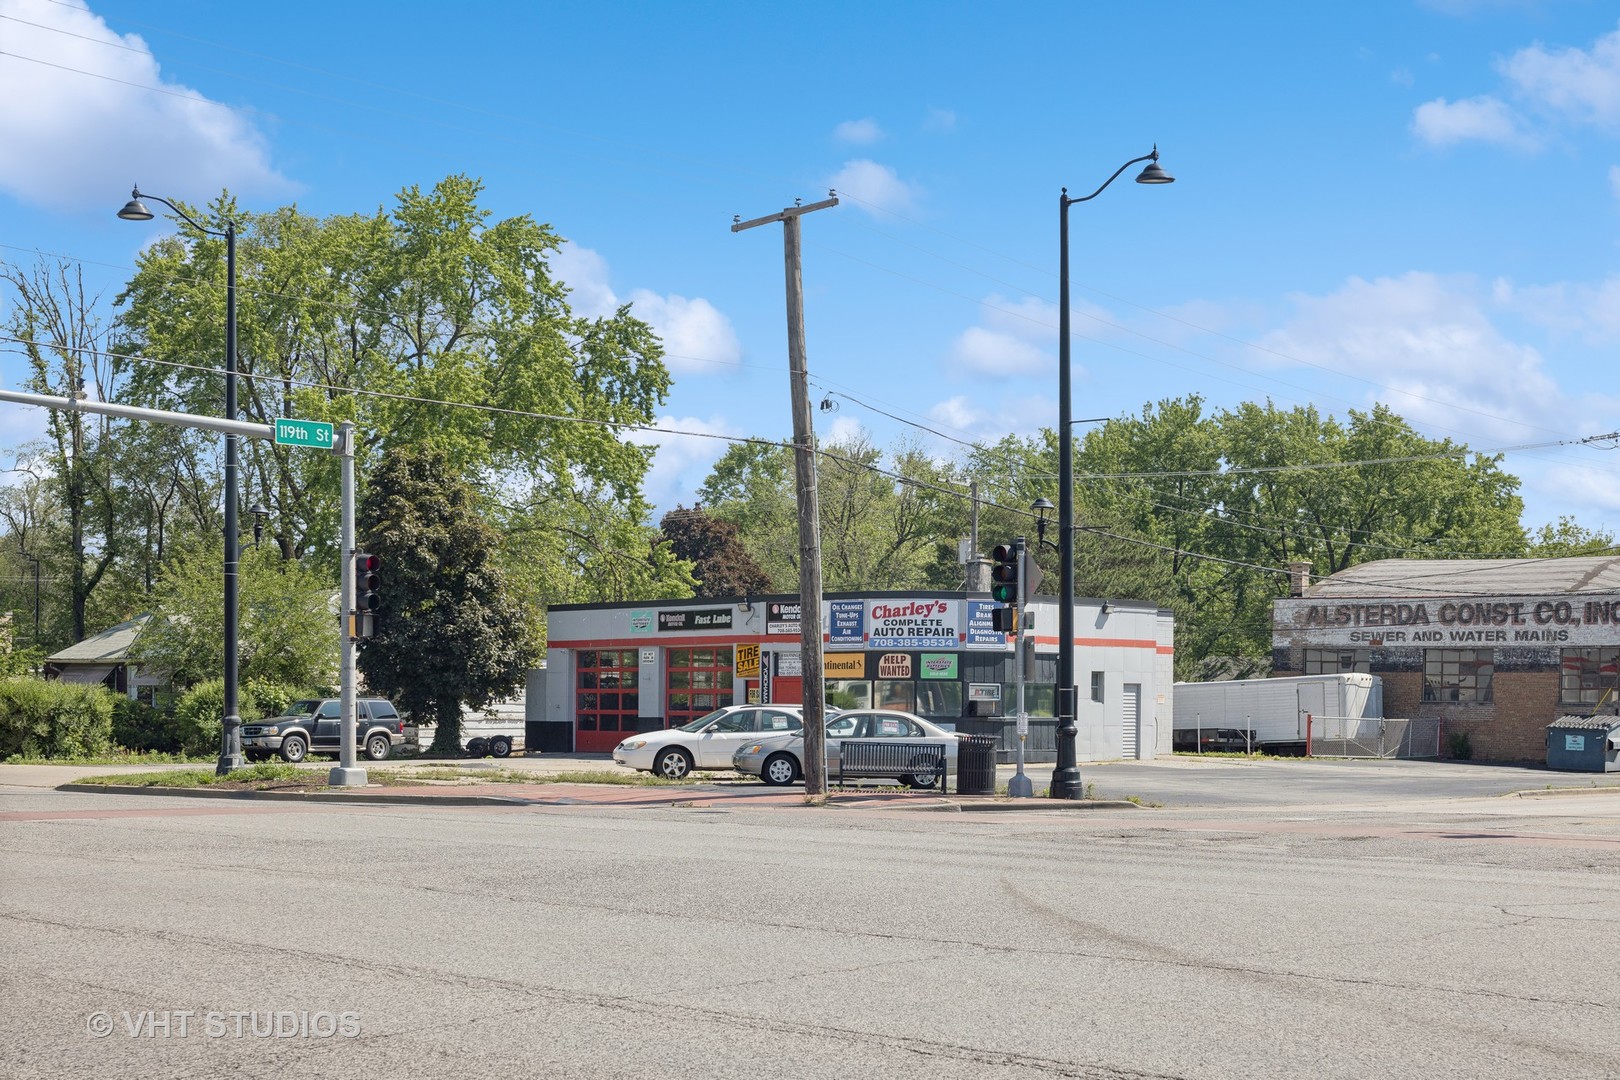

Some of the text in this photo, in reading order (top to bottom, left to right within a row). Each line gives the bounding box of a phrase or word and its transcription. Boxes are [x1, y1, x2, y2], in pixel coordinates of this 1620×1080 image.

[280, 426, 329, 442] 119th St
[871, 600, 947, 620] Charley's
[1306, 604, 1430, 626] ALSTERDA
[1438, 602, 1526, 626] CONST.
[694, 615, 711, 625] Fast
[712, 614, 732, 624] Lube
[883, 619, 942, 627] COMPLETE
[873, 628, 954, 637] AUTO REPAIR
[1350, 630, 1569, 642] SEWER AND WATER MAINS
[874, 639, 953, 647] 708-385-9534
[738, 645, 759, 661] TIRE
[737, 659, 759, 673] SALE
[884, 655, 907, 665] HELP
[880, 665, 910, 677] WANTED
